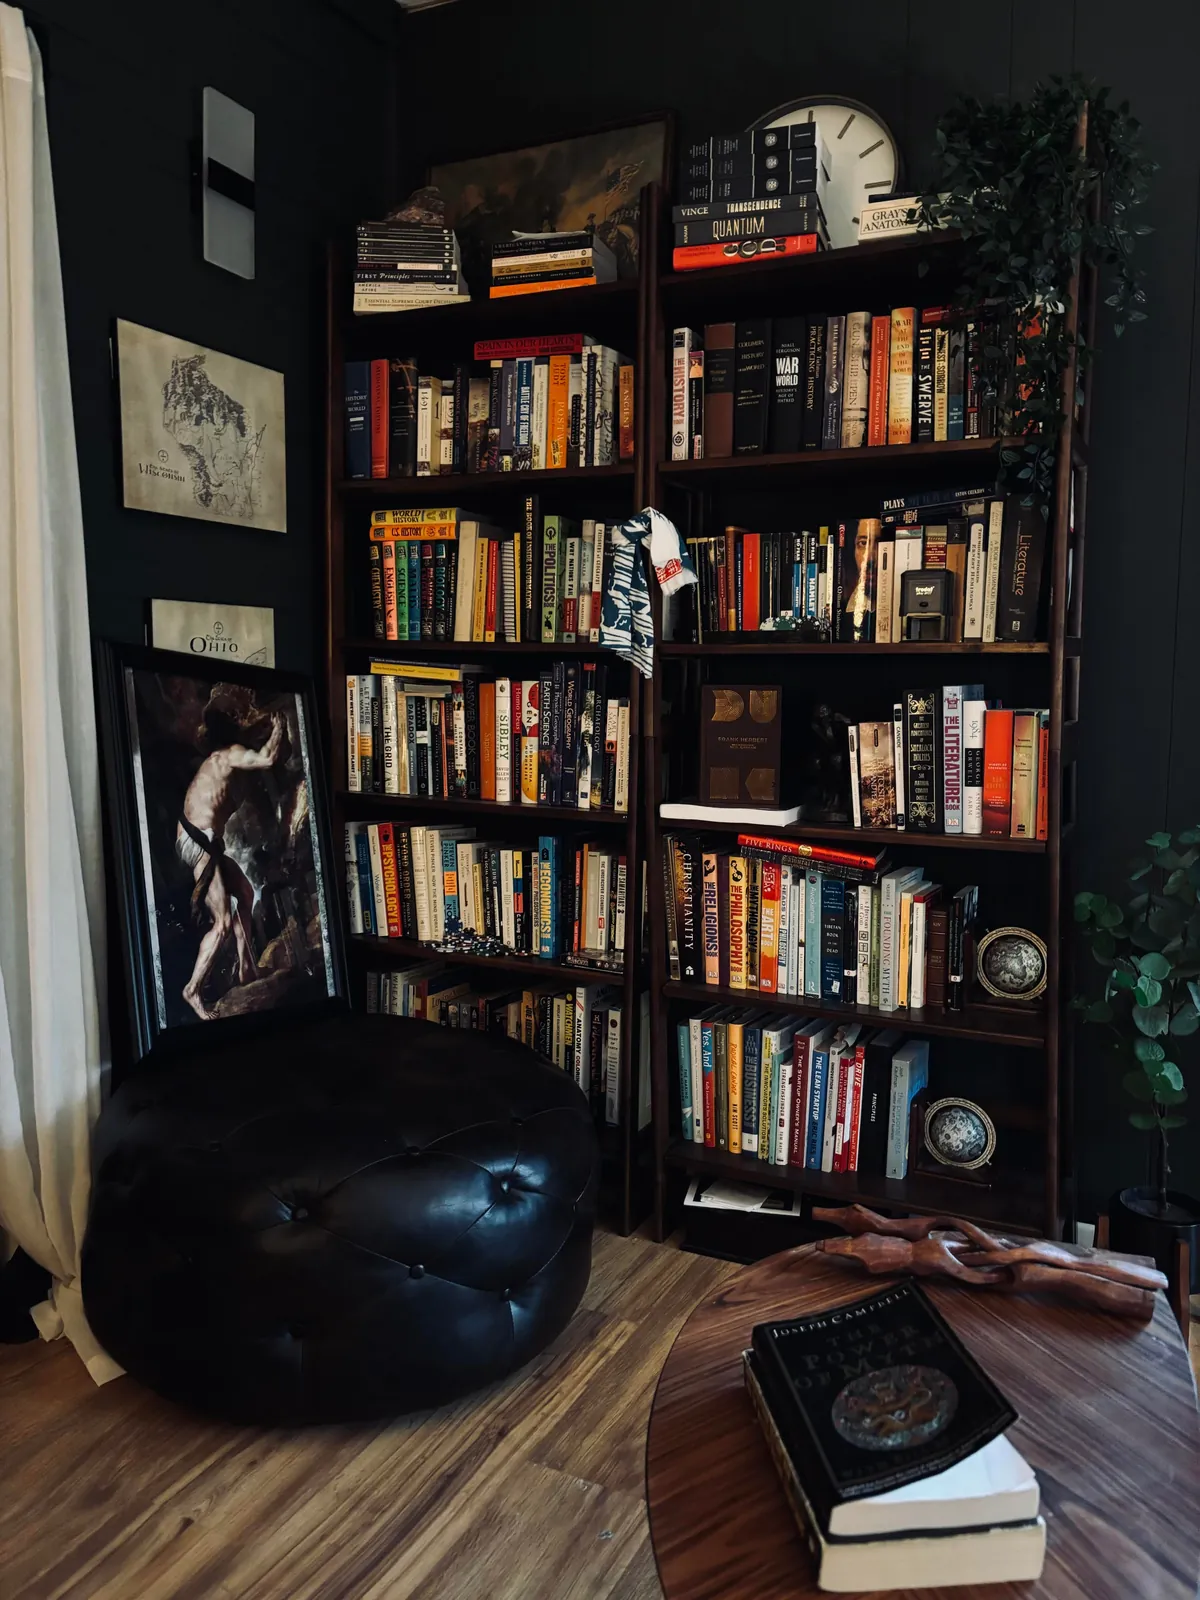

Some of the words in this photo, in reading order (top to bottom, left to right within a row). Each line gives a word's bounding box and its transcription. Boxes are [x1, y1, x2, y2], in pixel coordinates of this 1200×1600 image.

[681, 206, 709, 216] VINCE
[727, 198, 782, 214] TRANSCENDENCE
[712, 216, 765, 240] QUANTUM
[863, 218, 908, 233] ANATOM
[380, 273, 410, 281] Principles
[808, 325, 816, 373] PRACTICING
[775, 356, 799, 375] WAR
[775, 374, 799, 387] WORLD
[936, 365, 945, 394] SORROW
[346, 394, 368, 402] HISTORY
[520, 386, 531, 404] BATTLE
[673, 366, 686, 418] HISTORY
[806, 376, 814, 411] HISTORY
[918, 374, 932, 424] SWERVE
[519, 414, 530, 422] OF
[520, 404, 530, 414] CRY
[519, 422, 530, 446] FREEDOM
[525, 497, 533, 511] THE
[883, 498, 906, 510] PLAYS
[543, 550, 556, 602] POLITICS
[1015, 534, 1033, 596] Literature
[371, 567, 382, 610] CHEMISTRY
[386, 567, 394, 605] ENGLISH
[398, 567, 406, 608] SCIENCE
[435, 566, 446, 611] BIOLOGY
[808, 577, 816, 613] HAMLET
[968, 571, 976, 611] HEMINGWAY
[190, 637, 238, 653] OHIO
[466, 678, 475, 722] ANSWER
[543, 680, 552, 710] EARTH
[553, 691, 561, 714] Physical
[384, 726, 392, 744] THE
[542, 711, 551, 746] SCIENCE
[565, 707, 574, 750] GEOGRAPHY
[594, 694, 602, 755] ARCHAEOLOGY
[944, 716, 960, 725] THE
[970, 720, 980, 739] 1984
[467, 724, 476, 756] BOOK
[483, 732, 493, 762] Sapiens
[500, 715, 509, 760] SIBLEY
[910, 744, 933, 752] SHERLOCK
[385, 746, 393, 769] GRID
[912, 753, 931, 762] HOLMES
[944, 725, 961, 804] LITERATURE
[399, 832, 409, 867] BEYOND
[745, 838, 763, 848] FIVE
[765, 842, 793, 854] RINGS
[382, 851, 398, 917] PSYCHOLOGY
[401, 870, 411, 900] ORDER
[617, 877, 626, 907] SAMARITANS
[704, 881, 716, 890] THE
[730, 885, 743, 894] THE
[540, 869, 551, 933] ECONOMICS
[665, 890, 673, 933] RELIGIONS
[682, 852, 694, 951] CHRISTIANITY
[808, 886, 817, 924] Awakening
[704, 890, 718, 951] RELIGIONS
[730, 893, 743, 966] PHILOSOPHY
[748, 891, 759, 949] MYTHOLOGY
[761, 916, 775, 940] ART
[781, 914, 787, 926] UP
[779, 929, 787, 966] PHILOSOPHY
[882, 916, 892, 966] FOUNDING
[882, 967, 891, 995] MYTH
[564, 1003, 573, 1046] WATCHMEN
[702, 1050, 712, 1068] And
[730, 1042, 738, 1070] RADICAL
[744, 1055, 757, 1064] THE
[815, 1056, 823, 1070] THE
[743, 1064, 757, 1122] BUSINESS
[814, 1070, 822, 1089] LEAN
[812, 1090, 821, 1121] STARTUP
[870, 1092, 878, 1123] PRINCIPLES
[894, 1105, 903, 1136] personal
[811, 1121, 819, 1137] ERIC
[771, 1320, 828, 1339] JOSEPH
[831, 1287, 911, 1325] CAMPBELL
